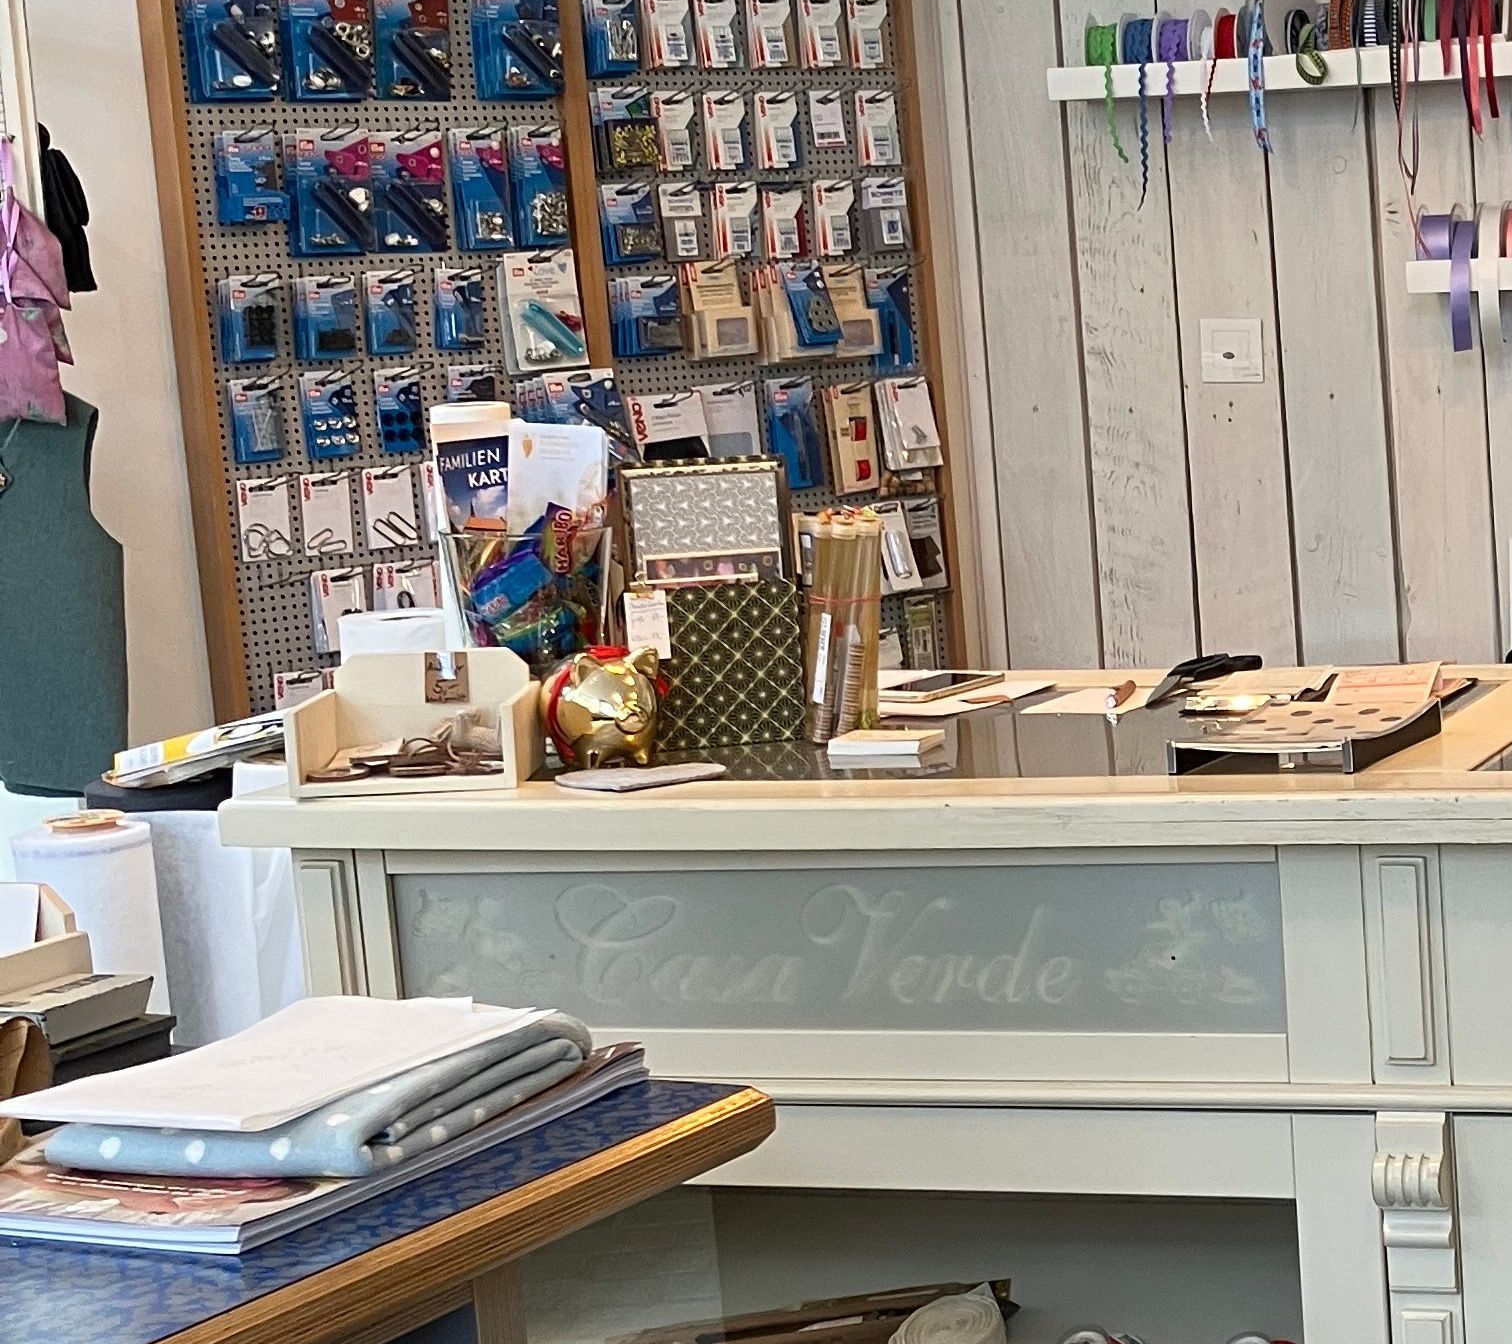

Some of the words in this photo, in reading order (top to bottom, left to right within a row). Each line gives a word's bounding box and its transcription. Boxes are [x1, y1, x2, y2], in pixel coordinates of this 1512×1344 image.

[631, 401, 649, 443] VENO
[439, 447, 501, 473] FAMILIEN
[468, 467, 508, 488] KART
[801, 883, 1084, 1006] Verde
